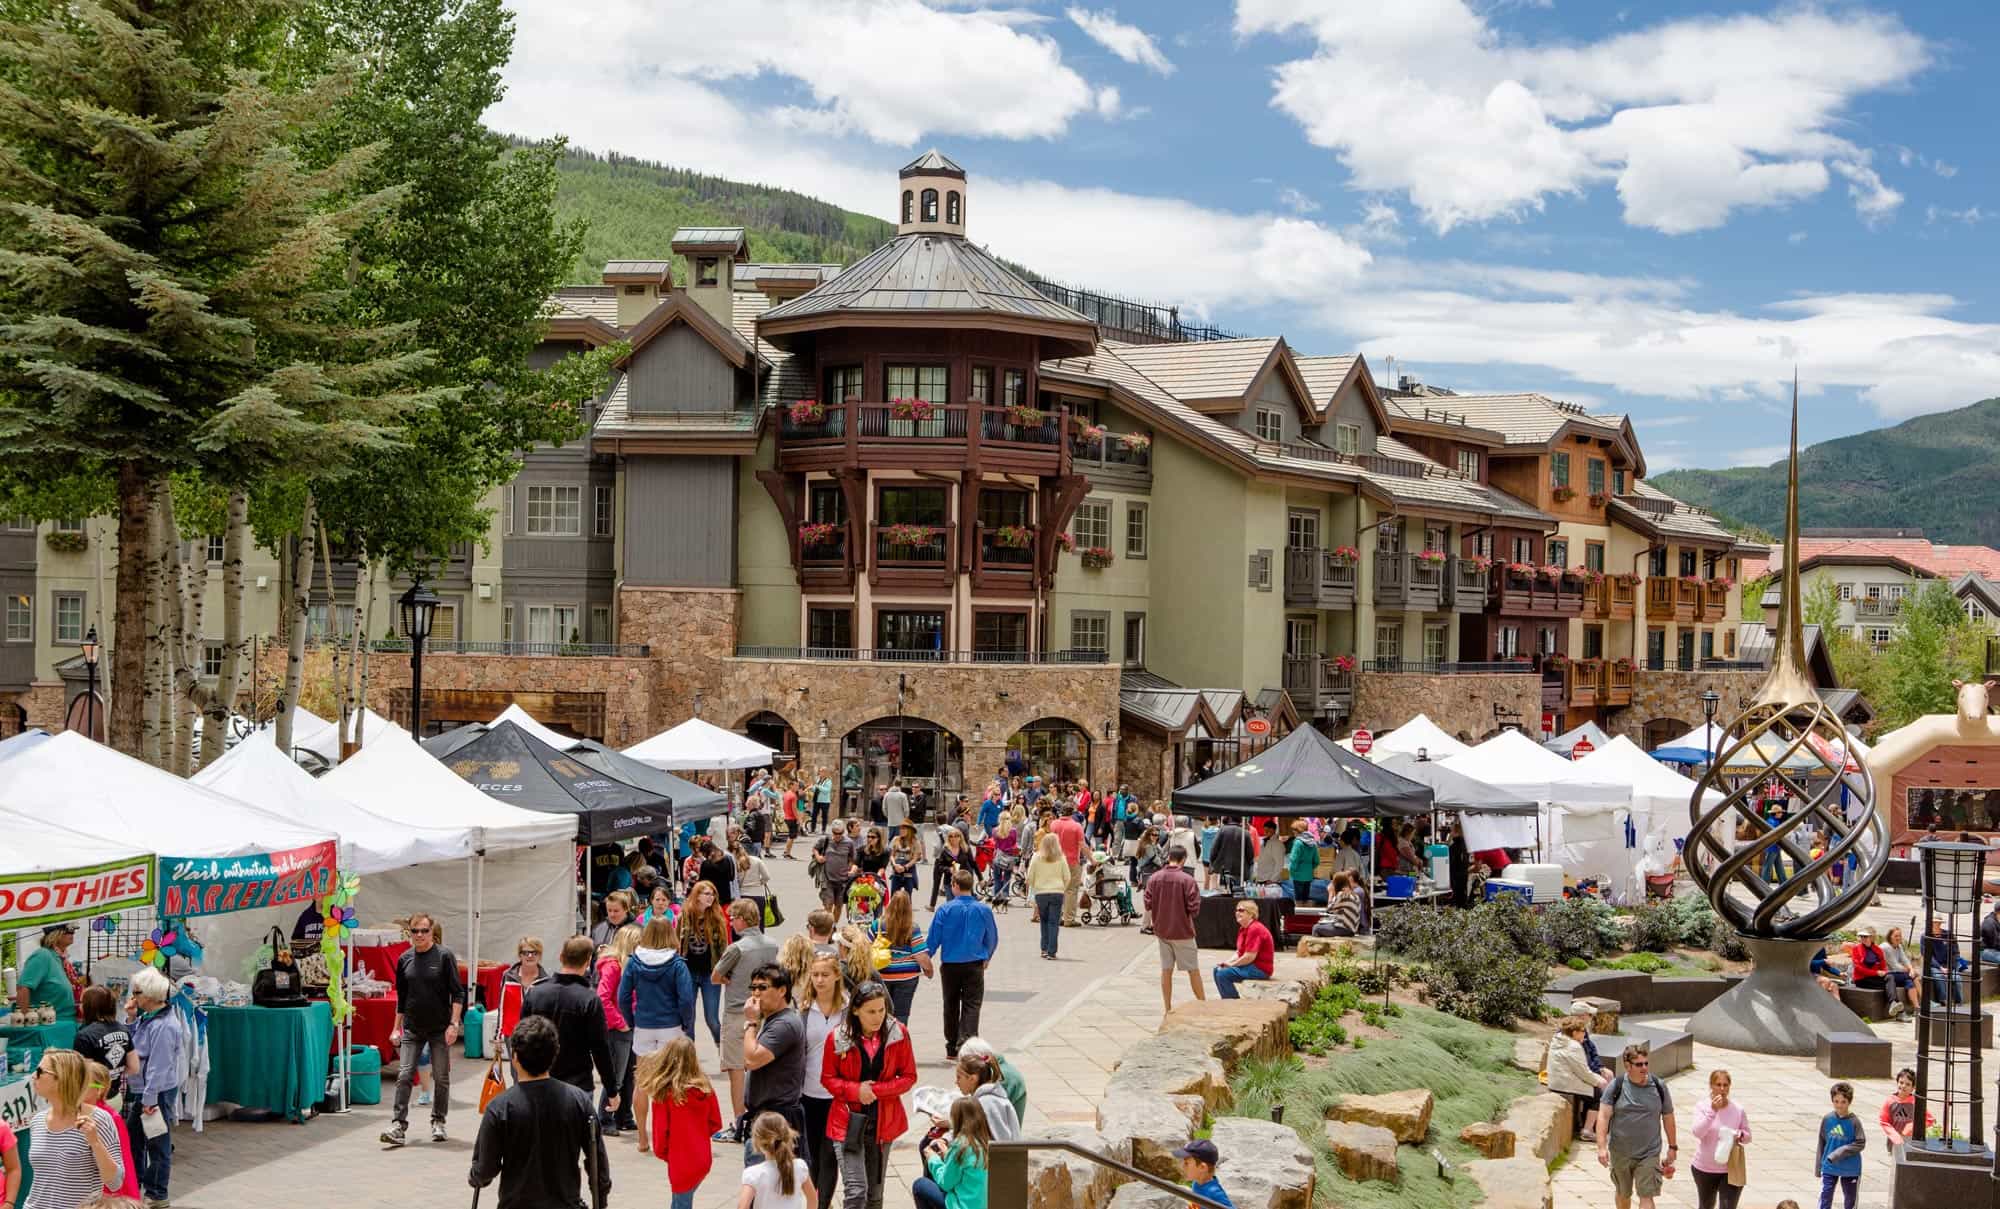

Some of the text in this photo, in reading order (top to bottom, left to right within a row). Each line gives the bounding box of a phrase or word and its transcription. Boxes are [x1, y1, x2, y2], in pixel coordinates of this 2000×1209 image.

[472, 783, 523, 792] IECES
[172, 860, 220, 881] Vail
[270, 855, 289, 875] and
[163, 867, 330, 916] MARKET GEAR
